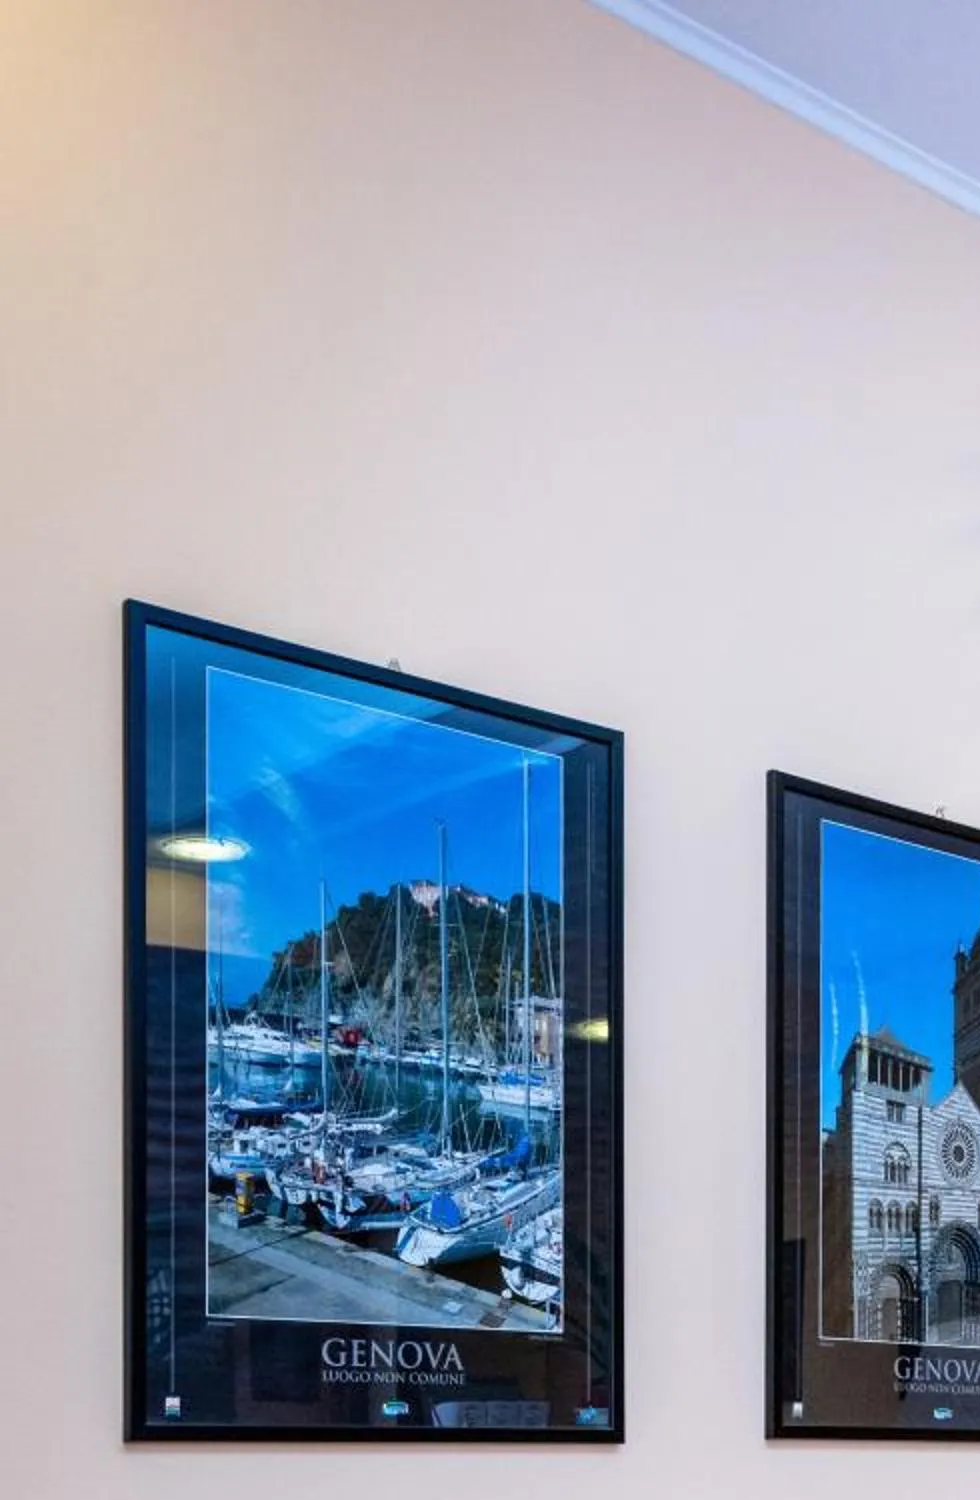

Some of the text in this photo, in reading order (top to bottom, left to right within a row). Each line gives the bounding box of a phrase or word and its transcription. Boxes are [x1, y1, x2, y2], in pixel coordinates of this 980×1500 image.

[321, 1337, 465, 1371] GENOVA
[322, 1370, 465, 1386] LUOGO NON COMUNE
